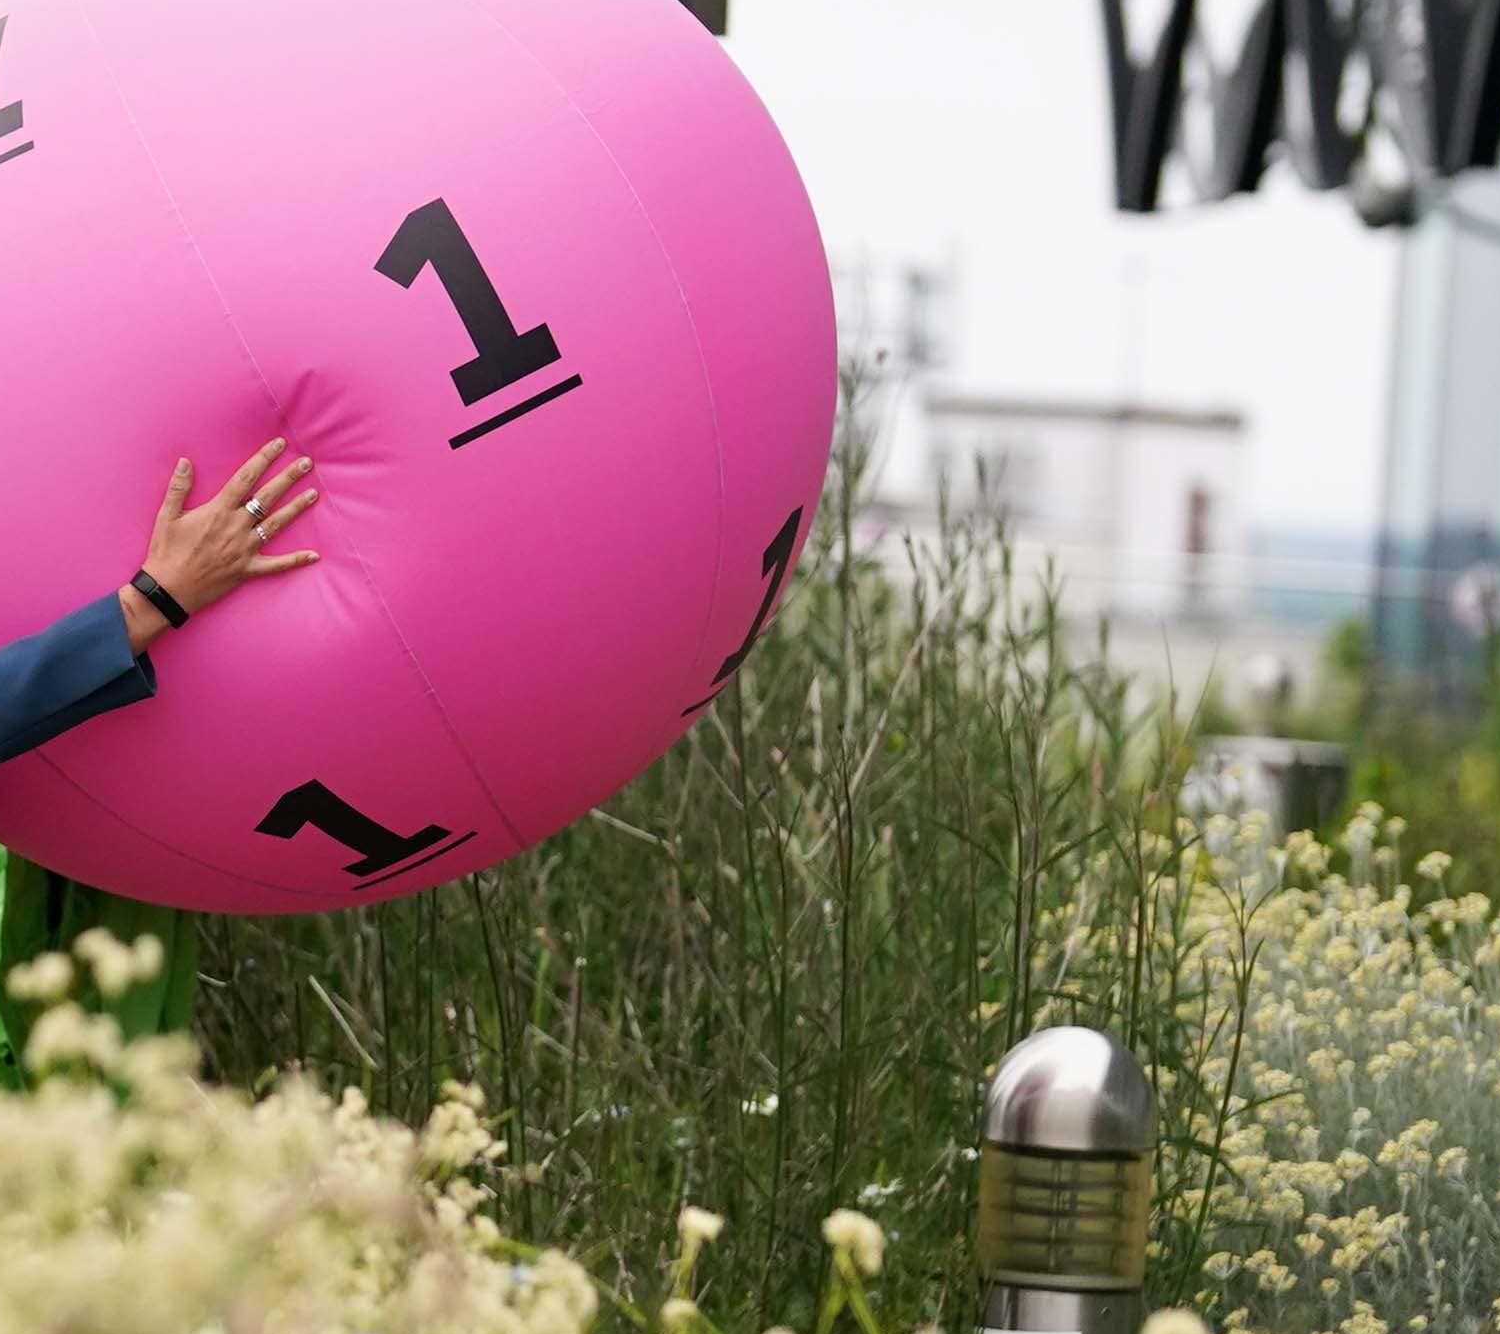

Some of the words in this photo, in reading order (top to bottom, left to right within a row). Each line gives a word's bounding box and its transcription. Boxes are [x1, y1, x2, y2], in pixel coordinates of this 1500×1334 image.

[373, 196, 562, 407] 1
[711, 504, 804, 687] 1
[253, 778, 453, 877] 1
